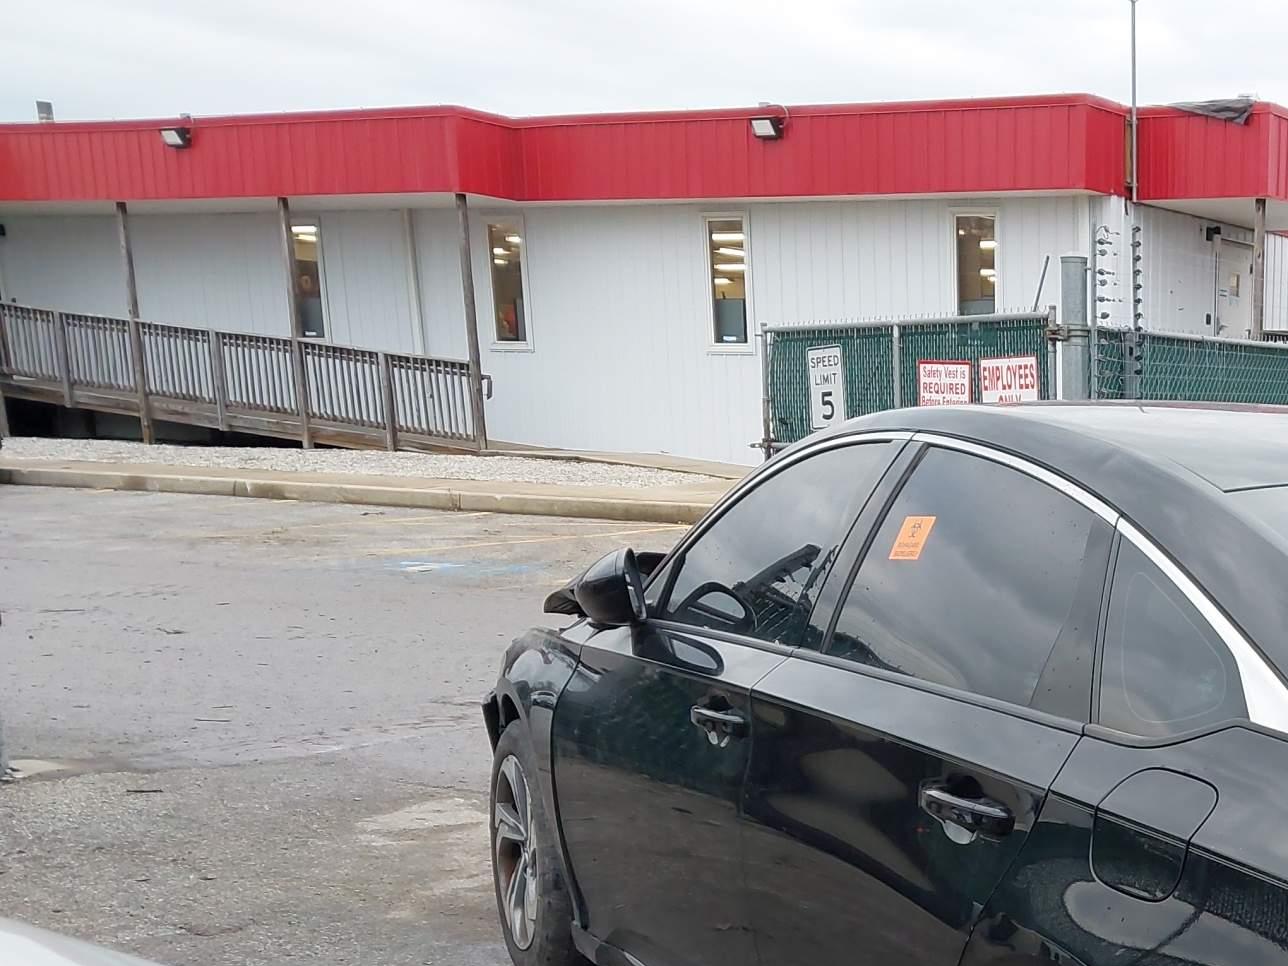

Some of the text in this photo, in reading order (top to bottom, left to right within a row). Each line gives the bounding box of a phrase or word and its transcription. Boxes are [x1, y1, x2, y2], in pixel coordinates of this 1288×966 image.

[810, 354, 839, 369] SPEED
[815, 372, 837, 386] LIMIT
[922, 366, 966, 381] Safety Vest is
[982, 363, 1035, 392] EMPLOYEES
[922, 382, 966, 395] REQUIRED
[821, 391, 835, 420] 5
